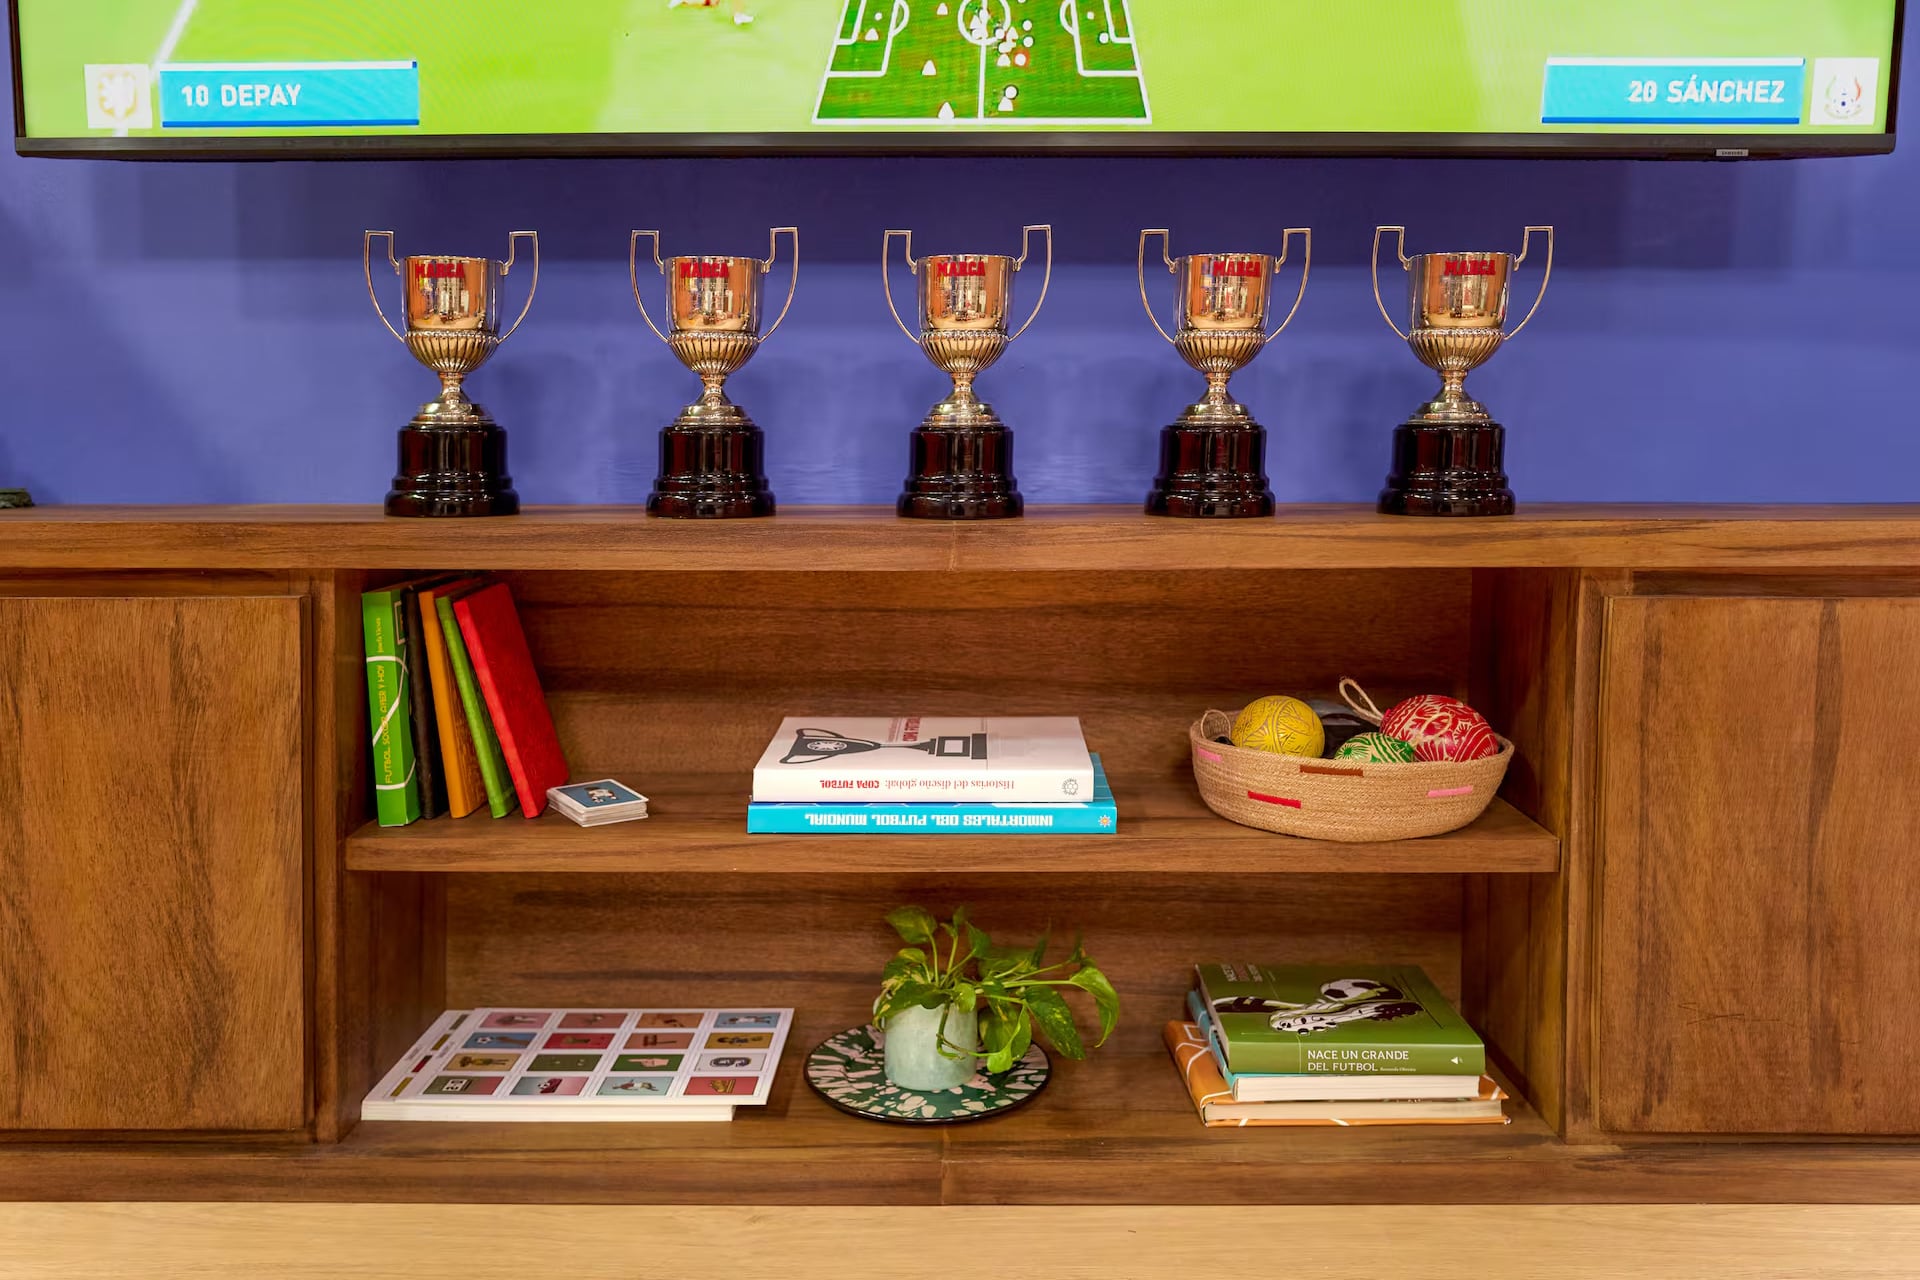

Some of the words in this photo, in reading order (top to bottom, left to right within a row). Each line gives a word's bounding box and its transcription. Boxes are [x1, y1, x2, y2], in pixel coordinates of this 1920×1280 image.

[181, 84, 209, 107] 10
[221, 84, 301, 107] DEPAY
[1627, 80, 1658, 103] 20
[1666, 74, 1786, 103] SÁNCHEZ
[415, 263, 466, 279] MARCA
[681, 262, 730, 279] MARCA
[937, 261, 987, 277] MARCA
[1213, 261, 1261, 277] MARCA
[1444, 259, 1496, 276] MARCA
[377, 665, 385, 683] HOY
[384, 747, 392, 783] FUTBOL
[819, 780, 854, 789] FUTBOL
[857, 780, 880, 789] COPA
[885, 778, 917, 790] global:
[919, 780, 952, 790] diseño
[953, 780, 969, 790] del
[970, 780, 1015, 790] Historias
[805, 813, 867, 826] MUNDIAL
[1307, 1049, 1339, 1060] NACE
[1341, 1050, 1359, 1060] UN
[1361, 1050, 1410, 1060] GRANDE
[1307, 1062, 1329, 1071] DEL
[1332, 1062, 1379, 1072] FUTBOL
